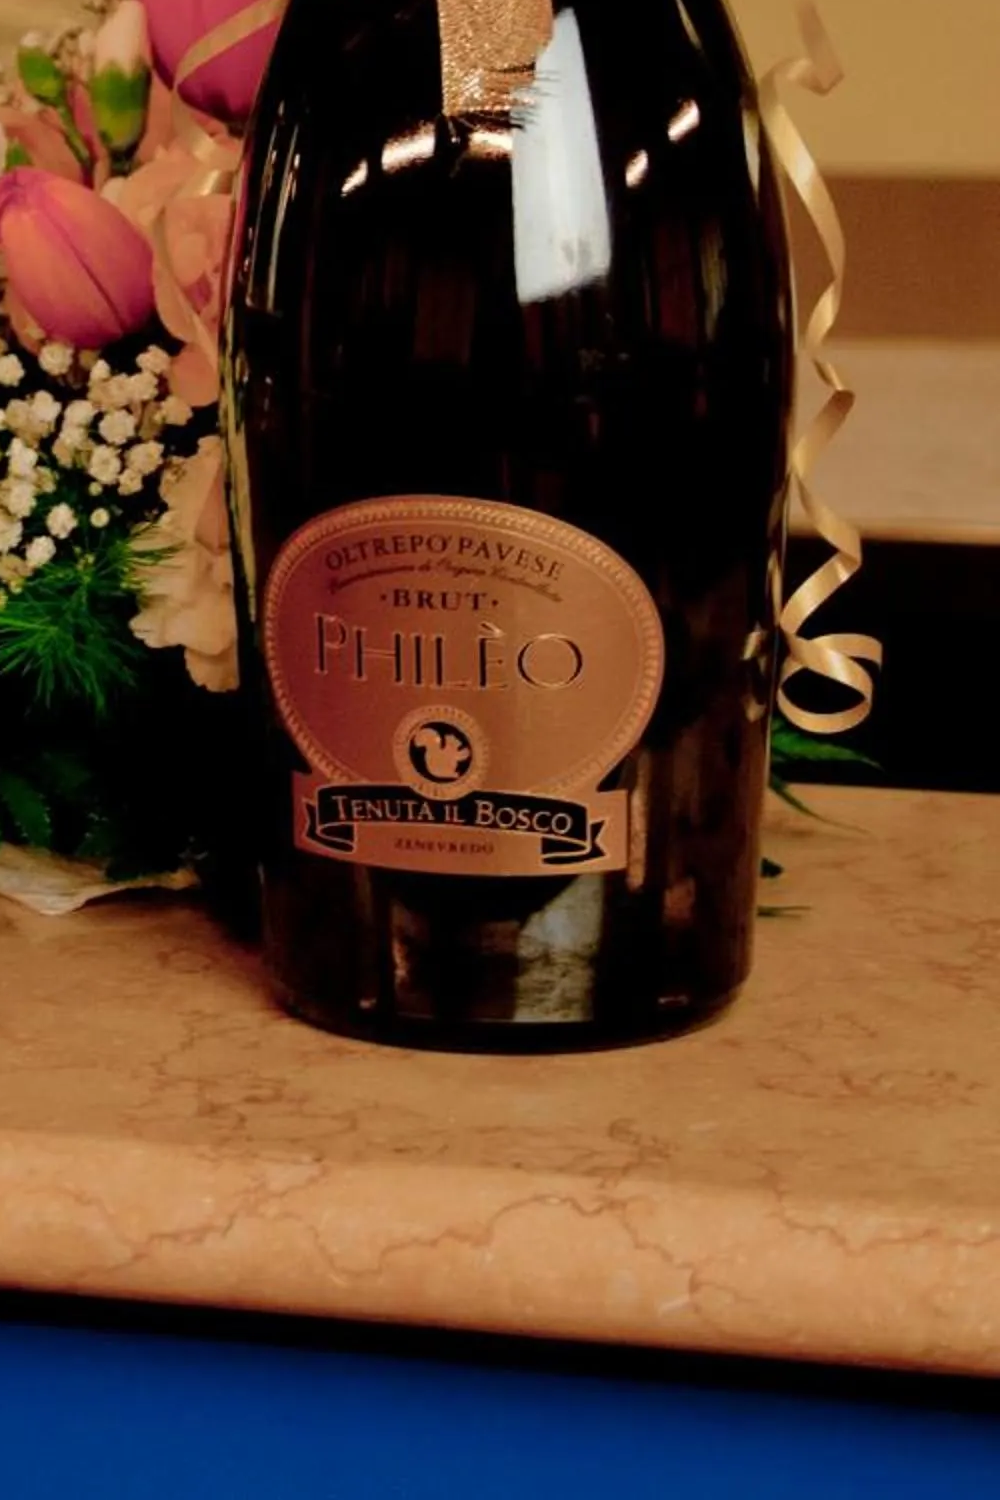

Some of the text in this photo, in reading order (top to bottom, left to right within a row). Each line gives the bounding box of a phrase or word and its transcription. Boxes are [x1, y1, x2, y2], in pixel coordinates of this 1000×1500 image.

[458, 535, 566, 582] PAVESE
[331, 794, 573, 835] TENUTA IL BOSCO
